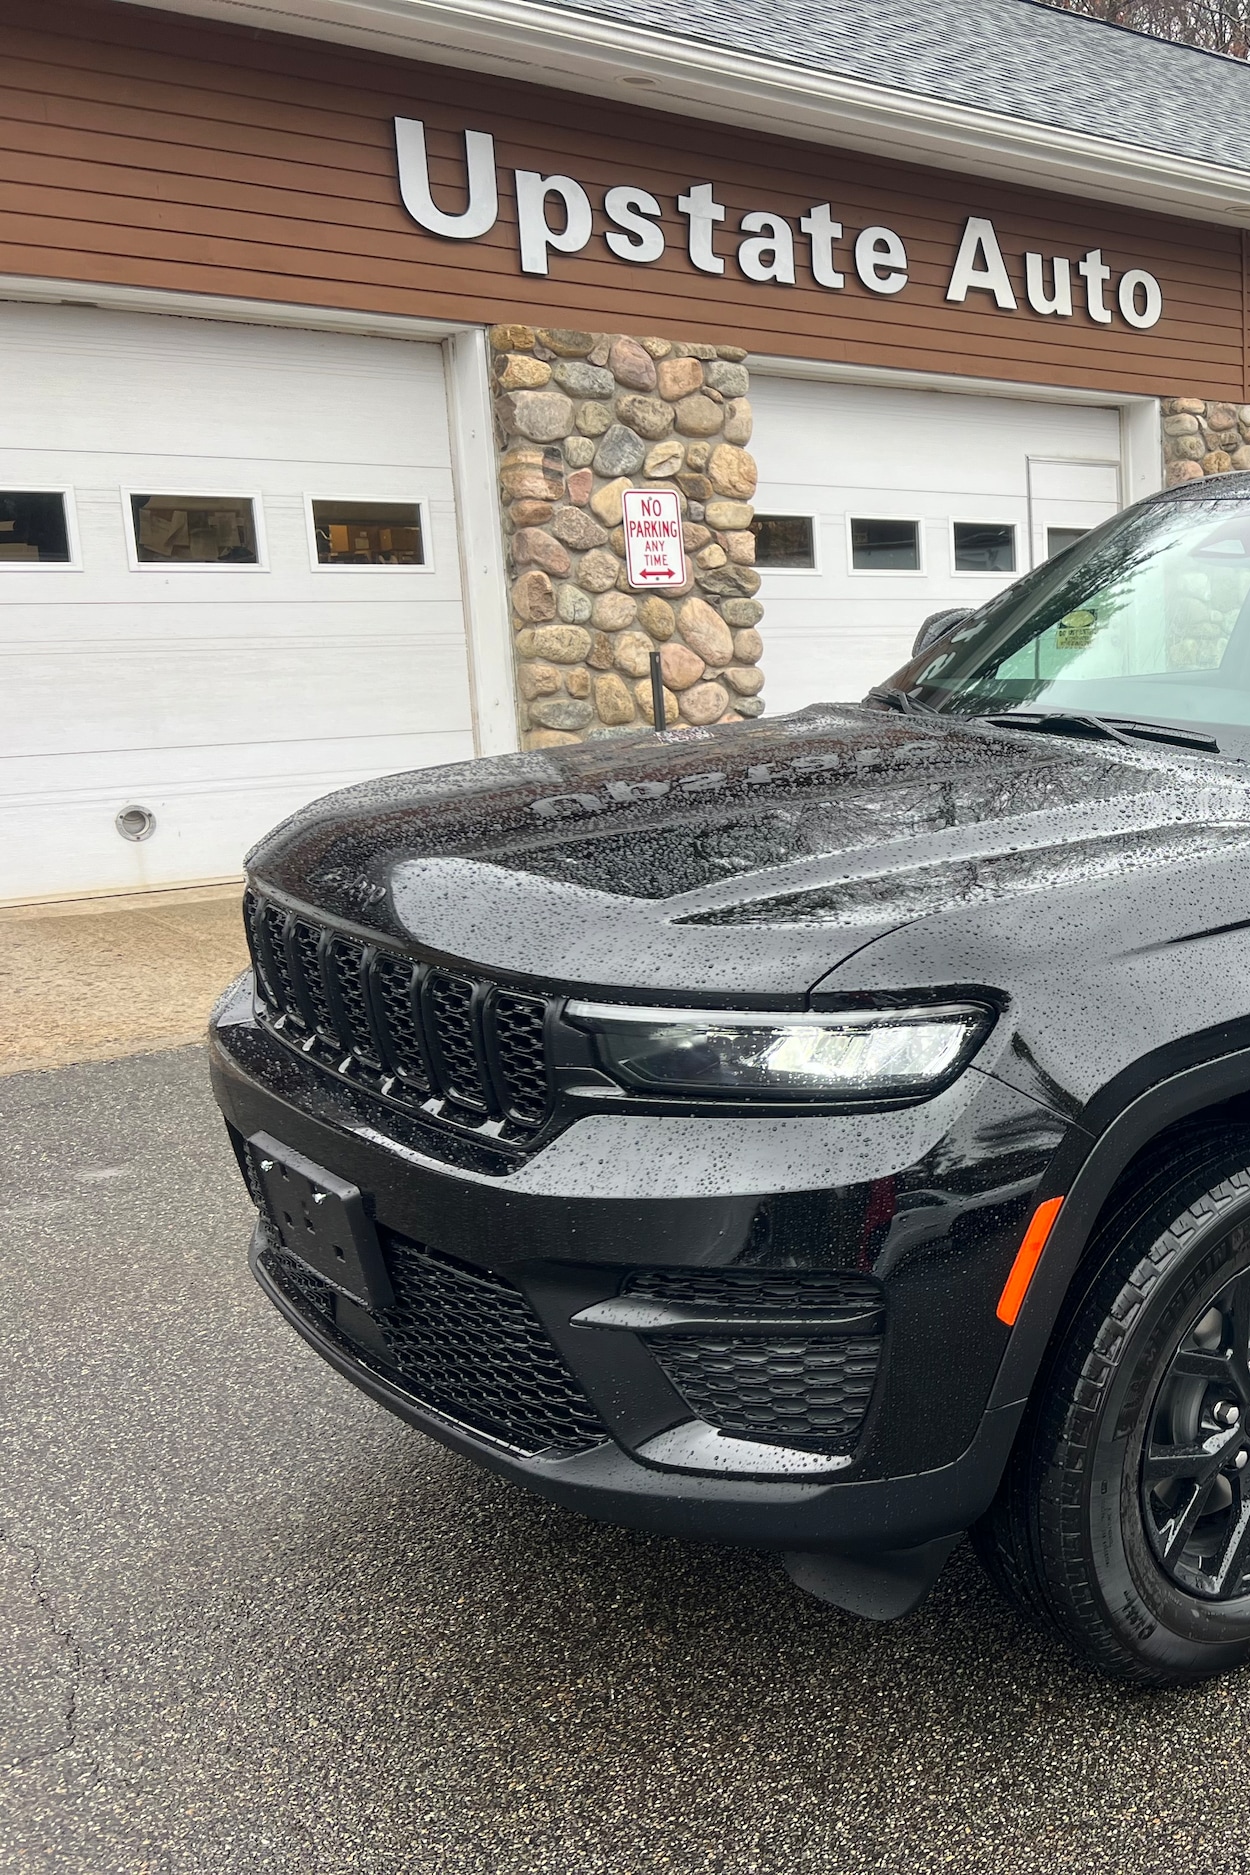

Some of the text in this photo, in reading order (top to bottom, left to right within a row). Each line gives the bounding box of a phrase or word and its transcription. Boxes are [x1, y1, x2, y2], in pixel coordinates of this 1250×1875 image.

[393, 116, 1163, 330] Upstate Auto
[640, 499, 662, 517] NO
[629, 520, 678, 538] PARKING
[644, 540, 665, 552] ANY
[643, 554, 669, 567] TIME
